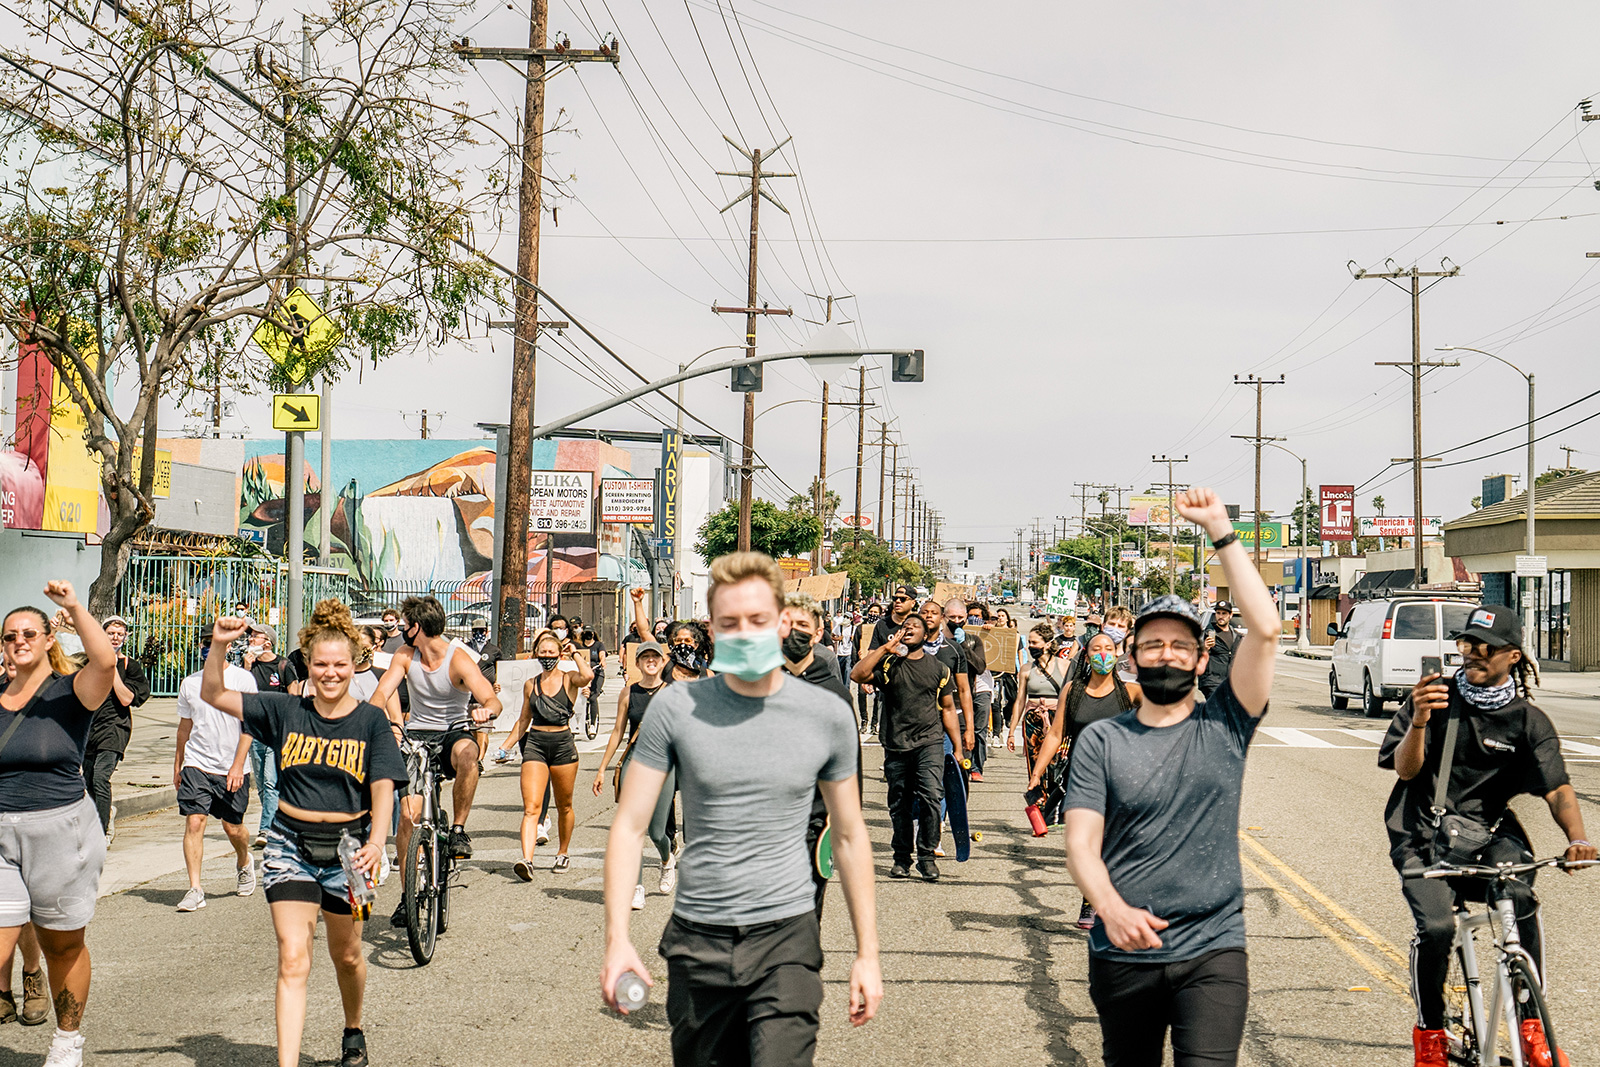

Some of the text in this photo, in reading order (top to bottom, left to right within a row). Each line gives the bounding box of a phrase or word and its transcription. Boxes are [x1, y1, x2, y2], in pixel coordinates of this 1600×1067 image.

[530, 474, 583, 488] ELIKA
[604, 481, 654, 491] CUSTOM T-SHIRTS
[556, 488, 588, 499] MOTORS
[664, 433, 678, 555] HARVEST
[1322, 490, 1353, 500] Lincoln
[549, 499, 585, 509] AUTOMOTIVE
[60, 501, 82, 523] 620
[546, 508, 559, 518] AND
[560, 509, 582, 518] REPAIR
[538, 518, 553, 529] 310
[554, 519, 588, 530] 396-2425
[1373, 517, 1405, 527] American
[1057, 588, 1065, 597] IS
[1051, 595, 1069, 606] THE
